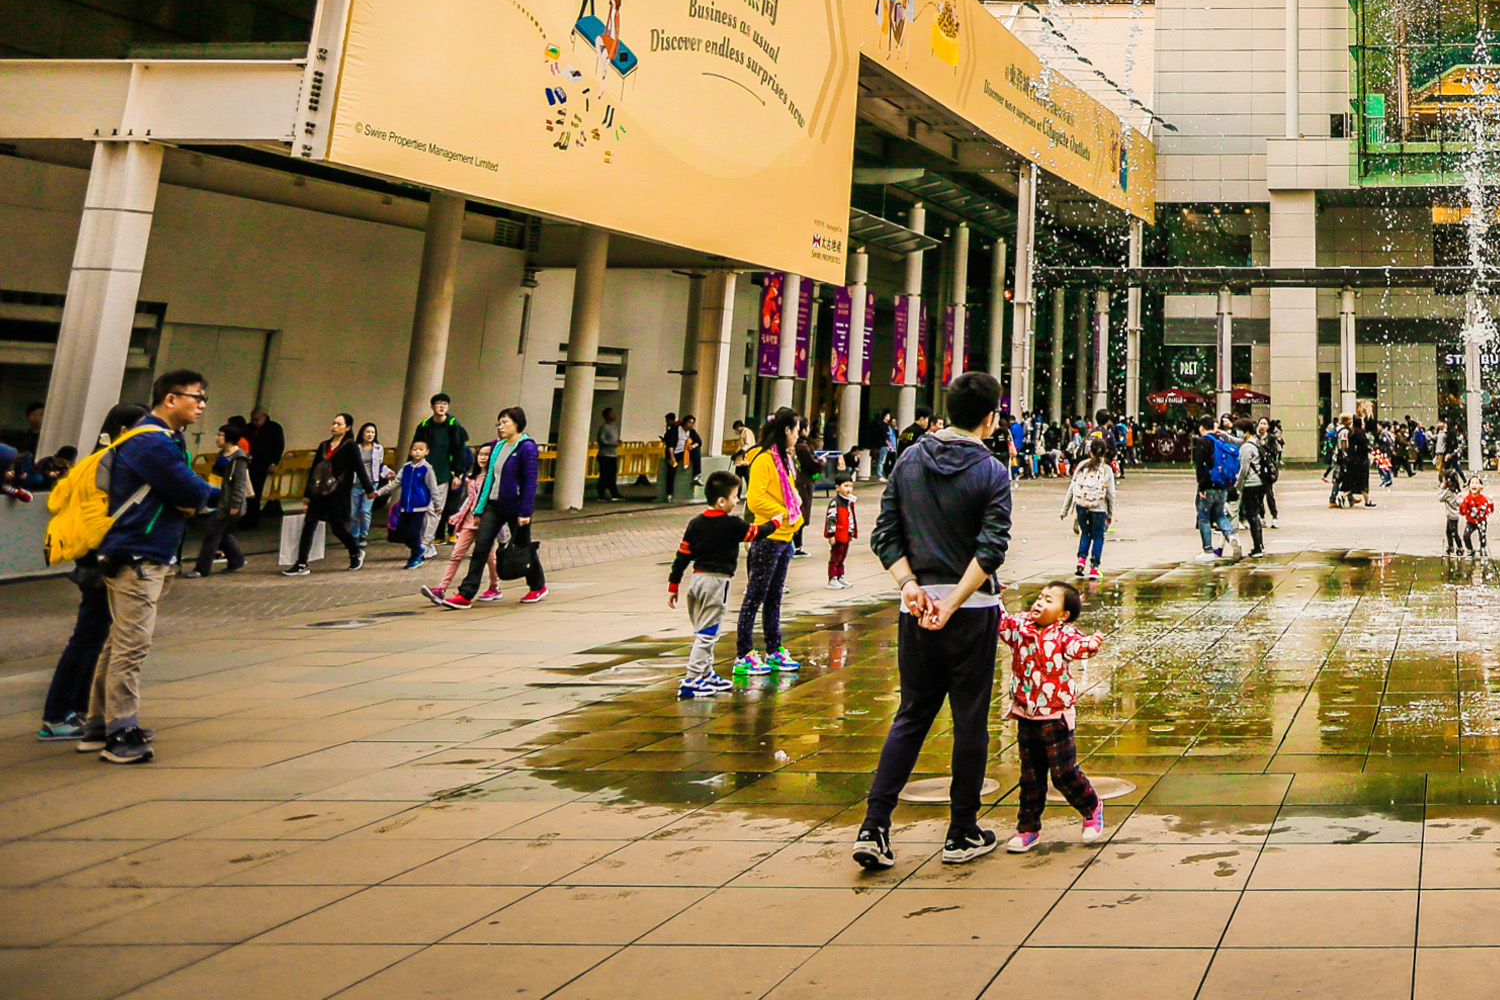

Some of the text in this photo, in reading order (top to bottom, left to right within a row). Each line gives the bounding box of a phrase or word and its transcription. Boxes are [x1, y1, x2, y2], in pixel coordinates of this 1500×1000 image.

[740, 20, 751, 37] as
[752, 30, 781, 64] usual
[650, 28, 806, 128] Discover endless surprises now
[364, 124, 387, 141] Swire
[388, 131, 428, 152] Properties
[428, 142, 475, 166] Management
[475, 156, 499, 172] Limited
[1180, 361, 1198, 376] PRET
